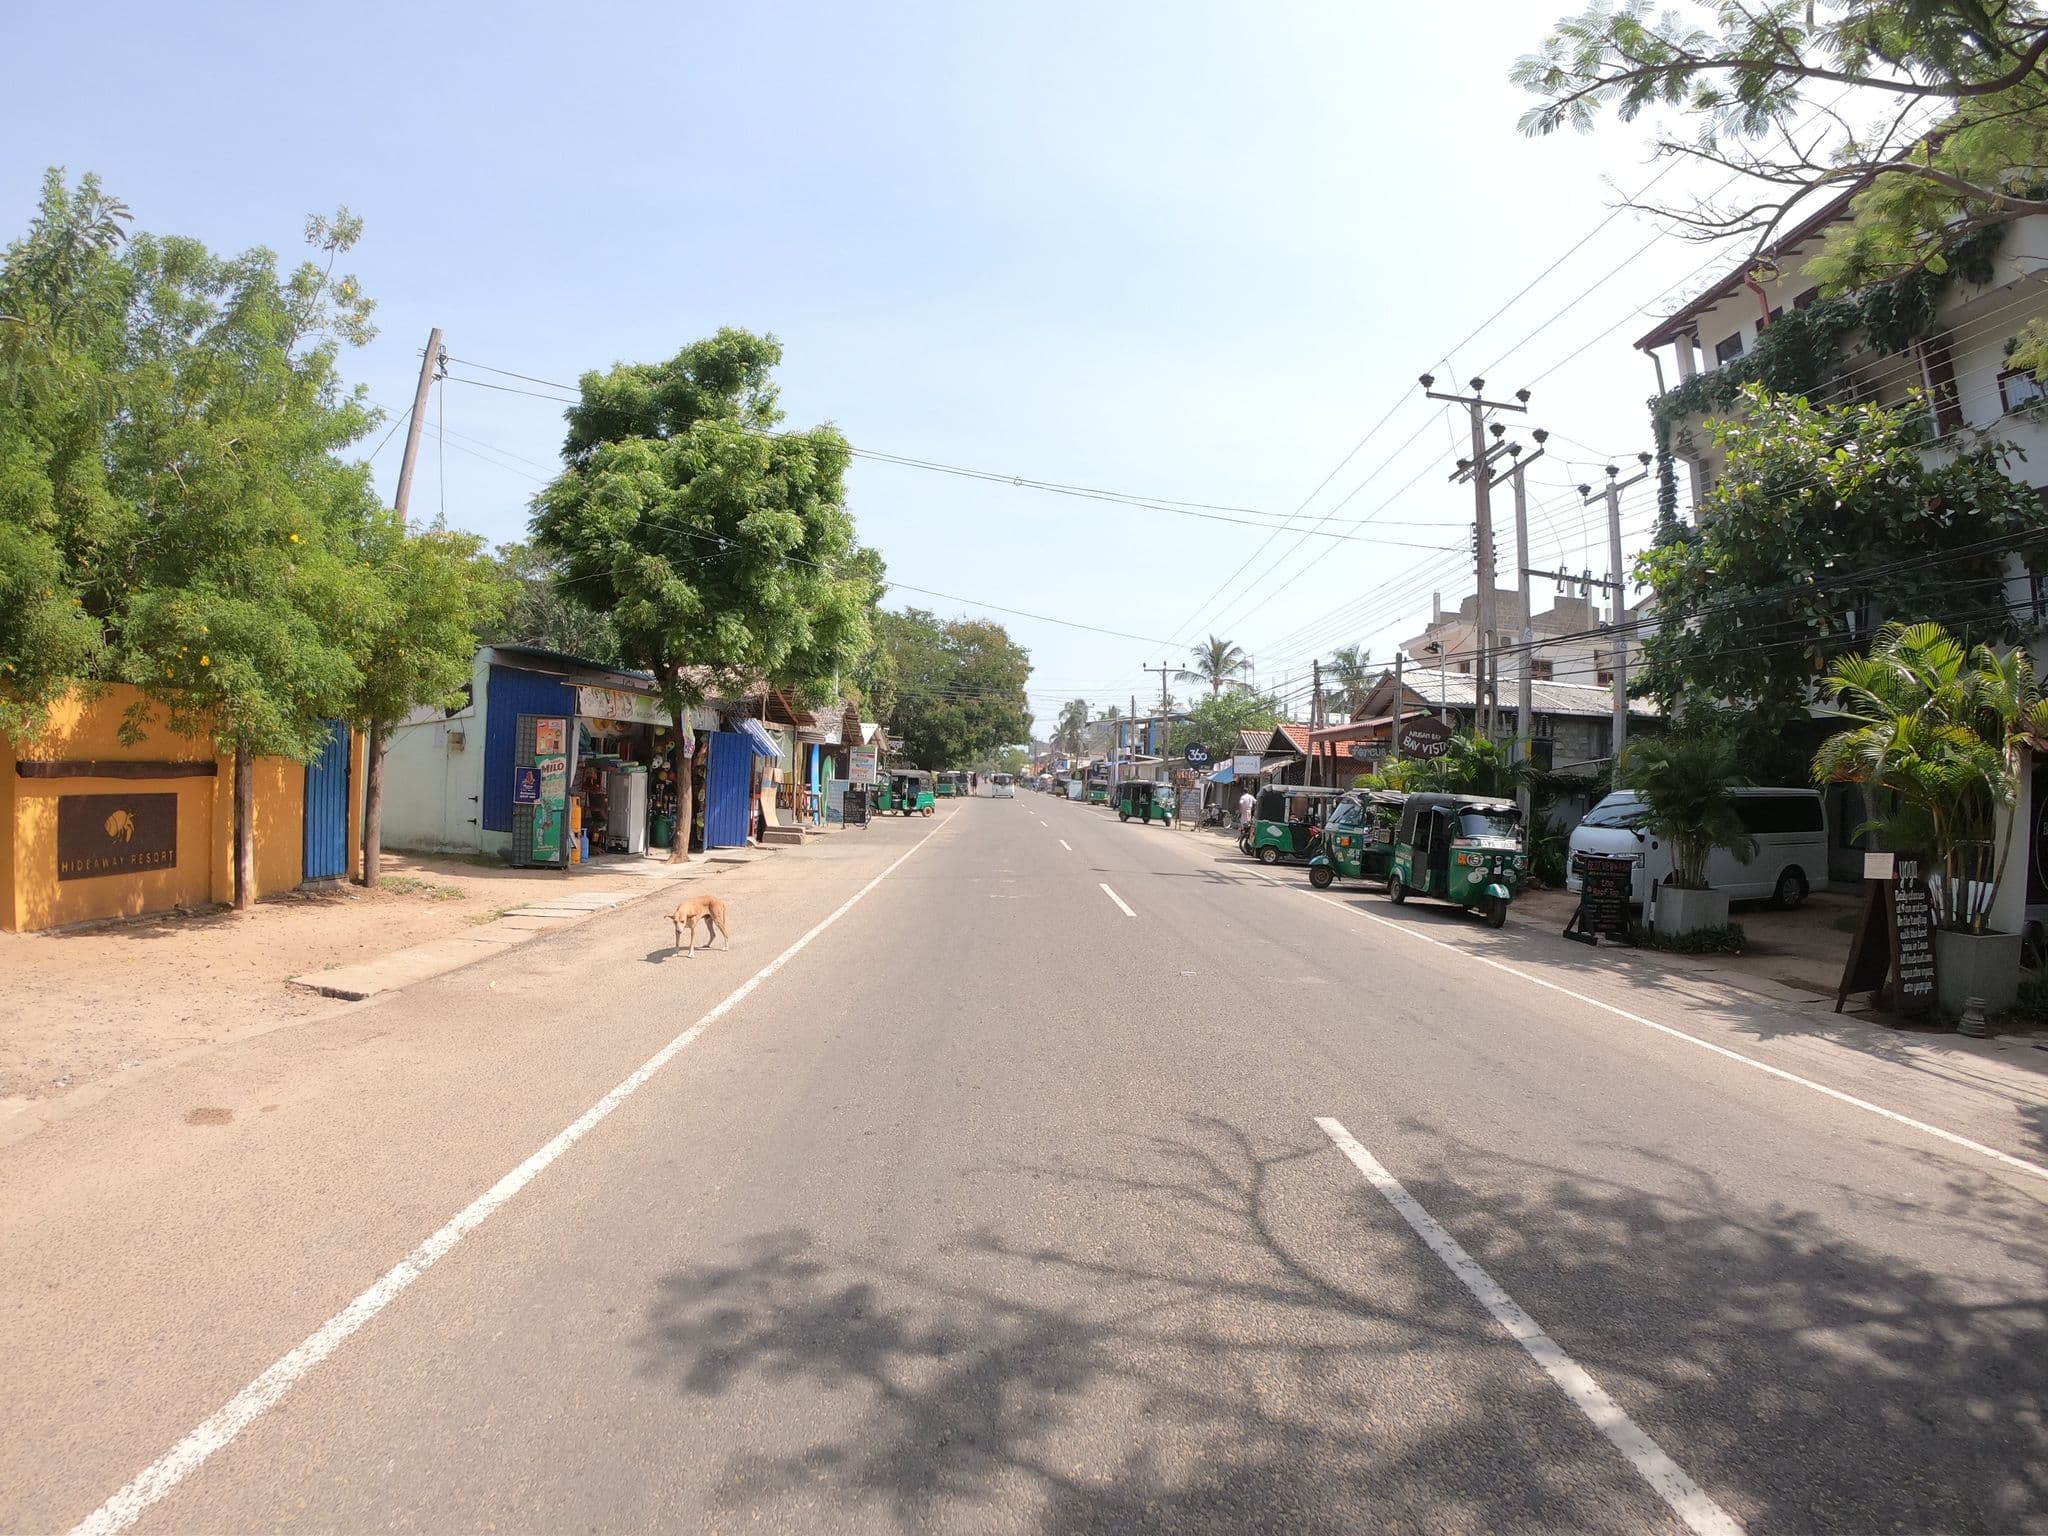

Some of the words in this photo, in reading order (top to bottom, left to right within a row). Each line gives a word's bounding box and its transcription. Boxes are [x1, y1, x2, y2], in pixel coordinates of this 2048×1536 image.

[1403, 735, 1421, 751] BAY
[1187, 748, 1208, 761] 360
[541, 762, 564, 774] MILO
[61, 856, 124, 873] HIDEAWAY
[131, 850, 174, 864] RESORT
